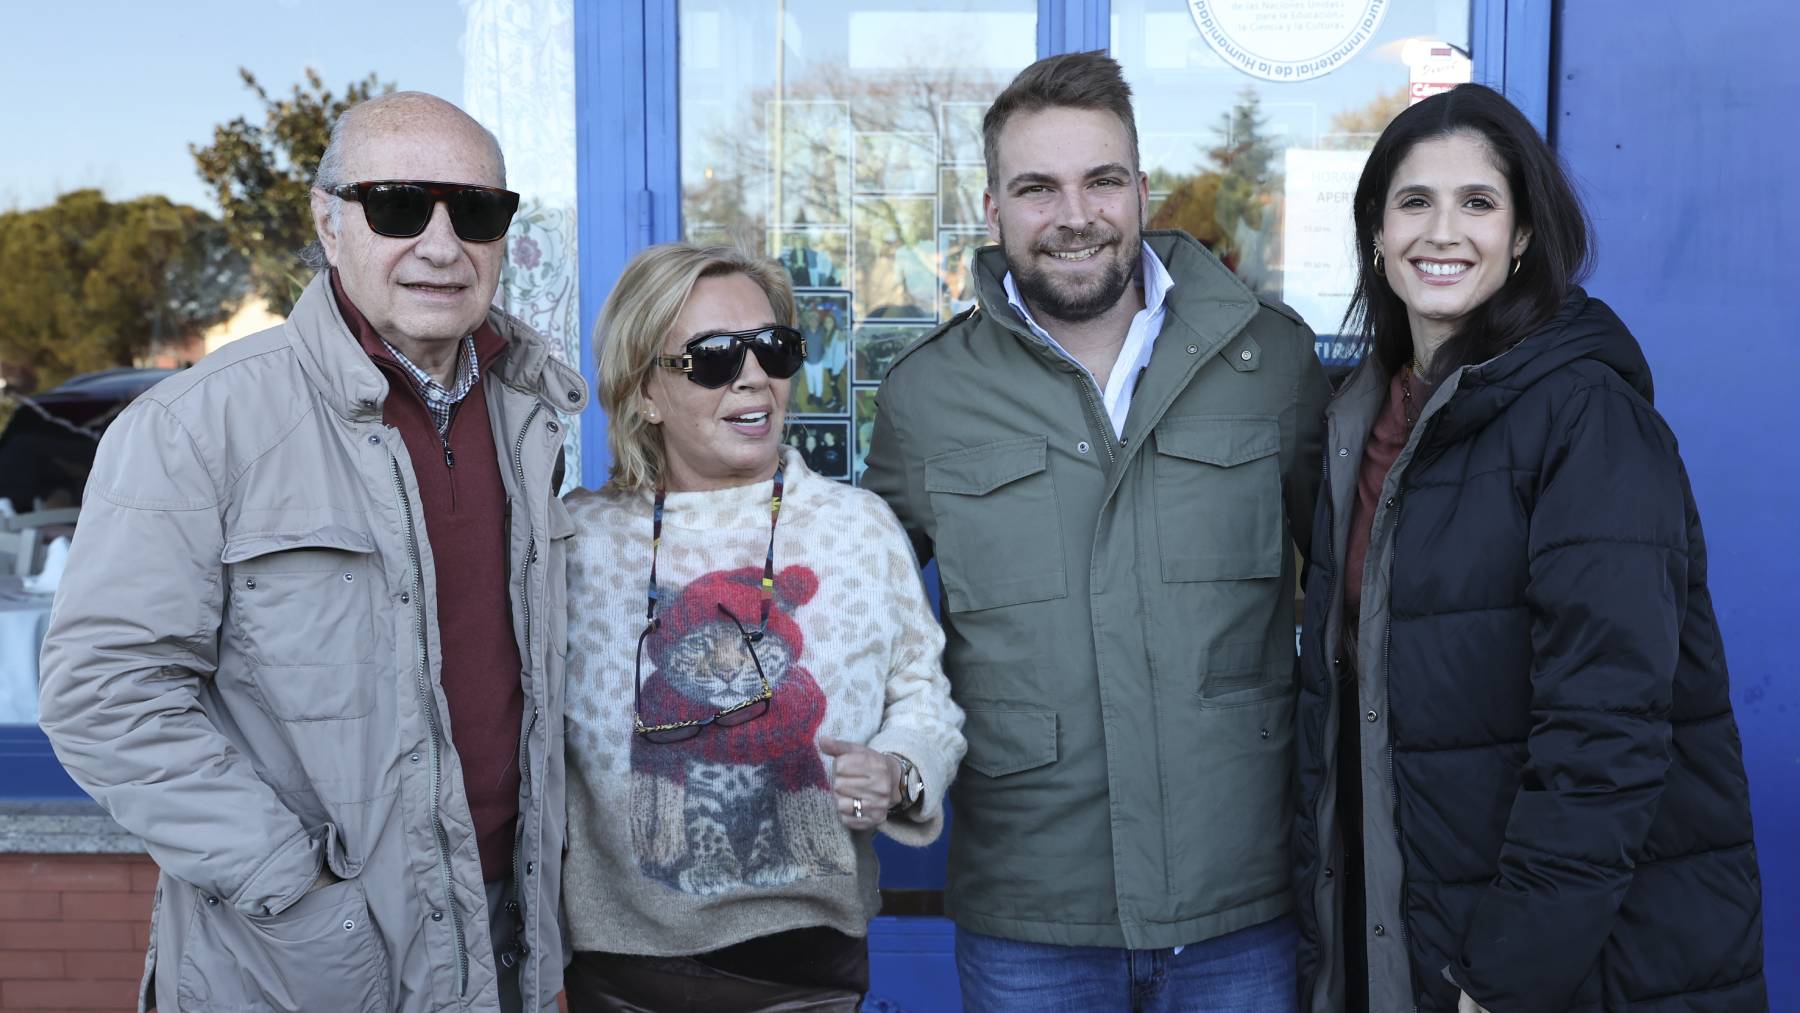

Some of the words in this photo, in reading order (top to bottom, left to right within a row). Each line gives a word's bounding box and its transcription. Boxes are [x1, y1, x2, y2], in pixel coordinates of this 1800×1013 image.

[1193, 0, 1257, 70] Humanidad
[1258, 62, 1272, 76] la
[1296, 30, 1366, 78] Inmaterial
[1274, 65, 1293, 78] de
